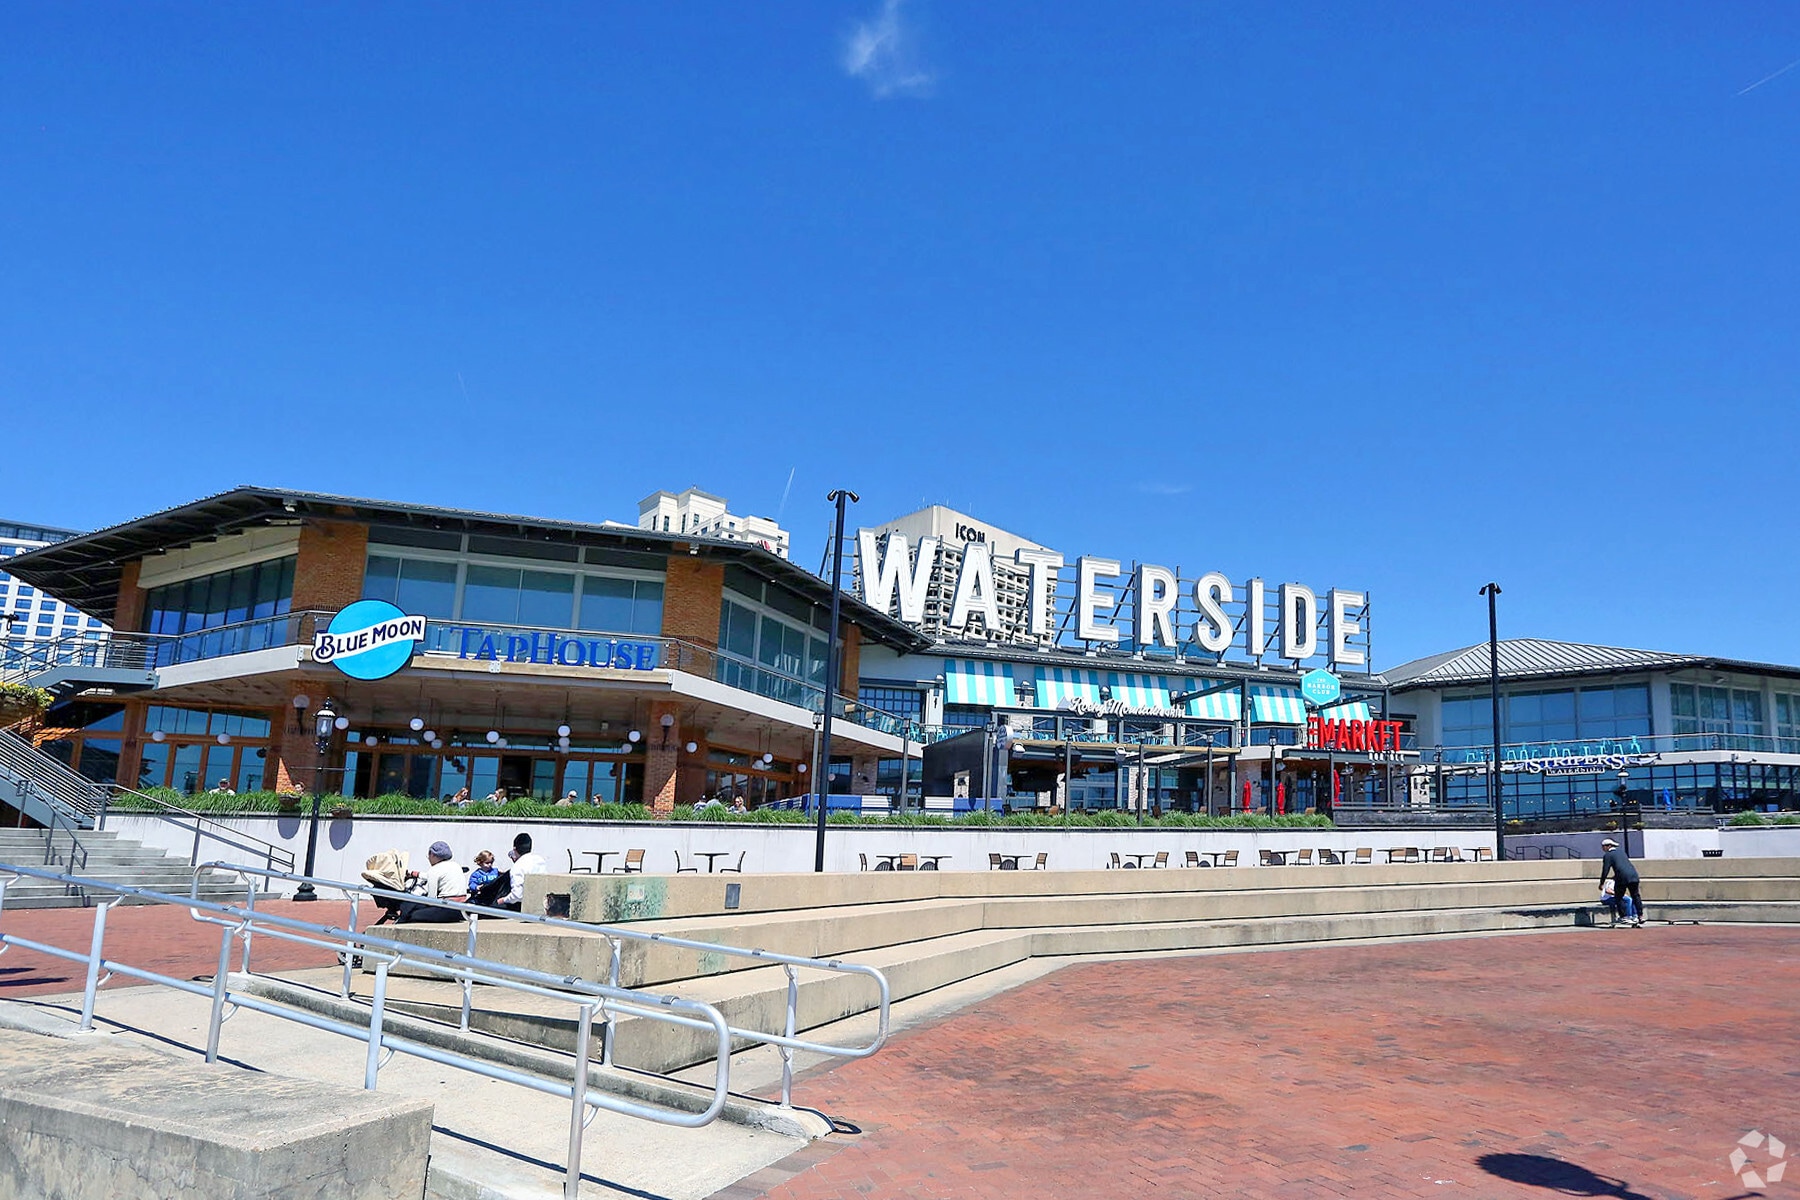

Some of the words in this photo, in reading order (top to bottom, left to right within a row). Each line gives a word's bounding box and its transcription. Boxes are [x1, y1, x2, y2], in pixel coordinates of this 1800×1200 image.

[955, 522, 985, 543] ICON
[856, 527, 1368, 665] WATERSIDE
[315, 631, 368, 660] BLUE
[372, 620, 422, 645] MOON
[1306, 682, 1336, 691] HARBOR
[1317, 716, 1404, 752] MARKET
[1529, 754, 1624, 774] STRIPERS
